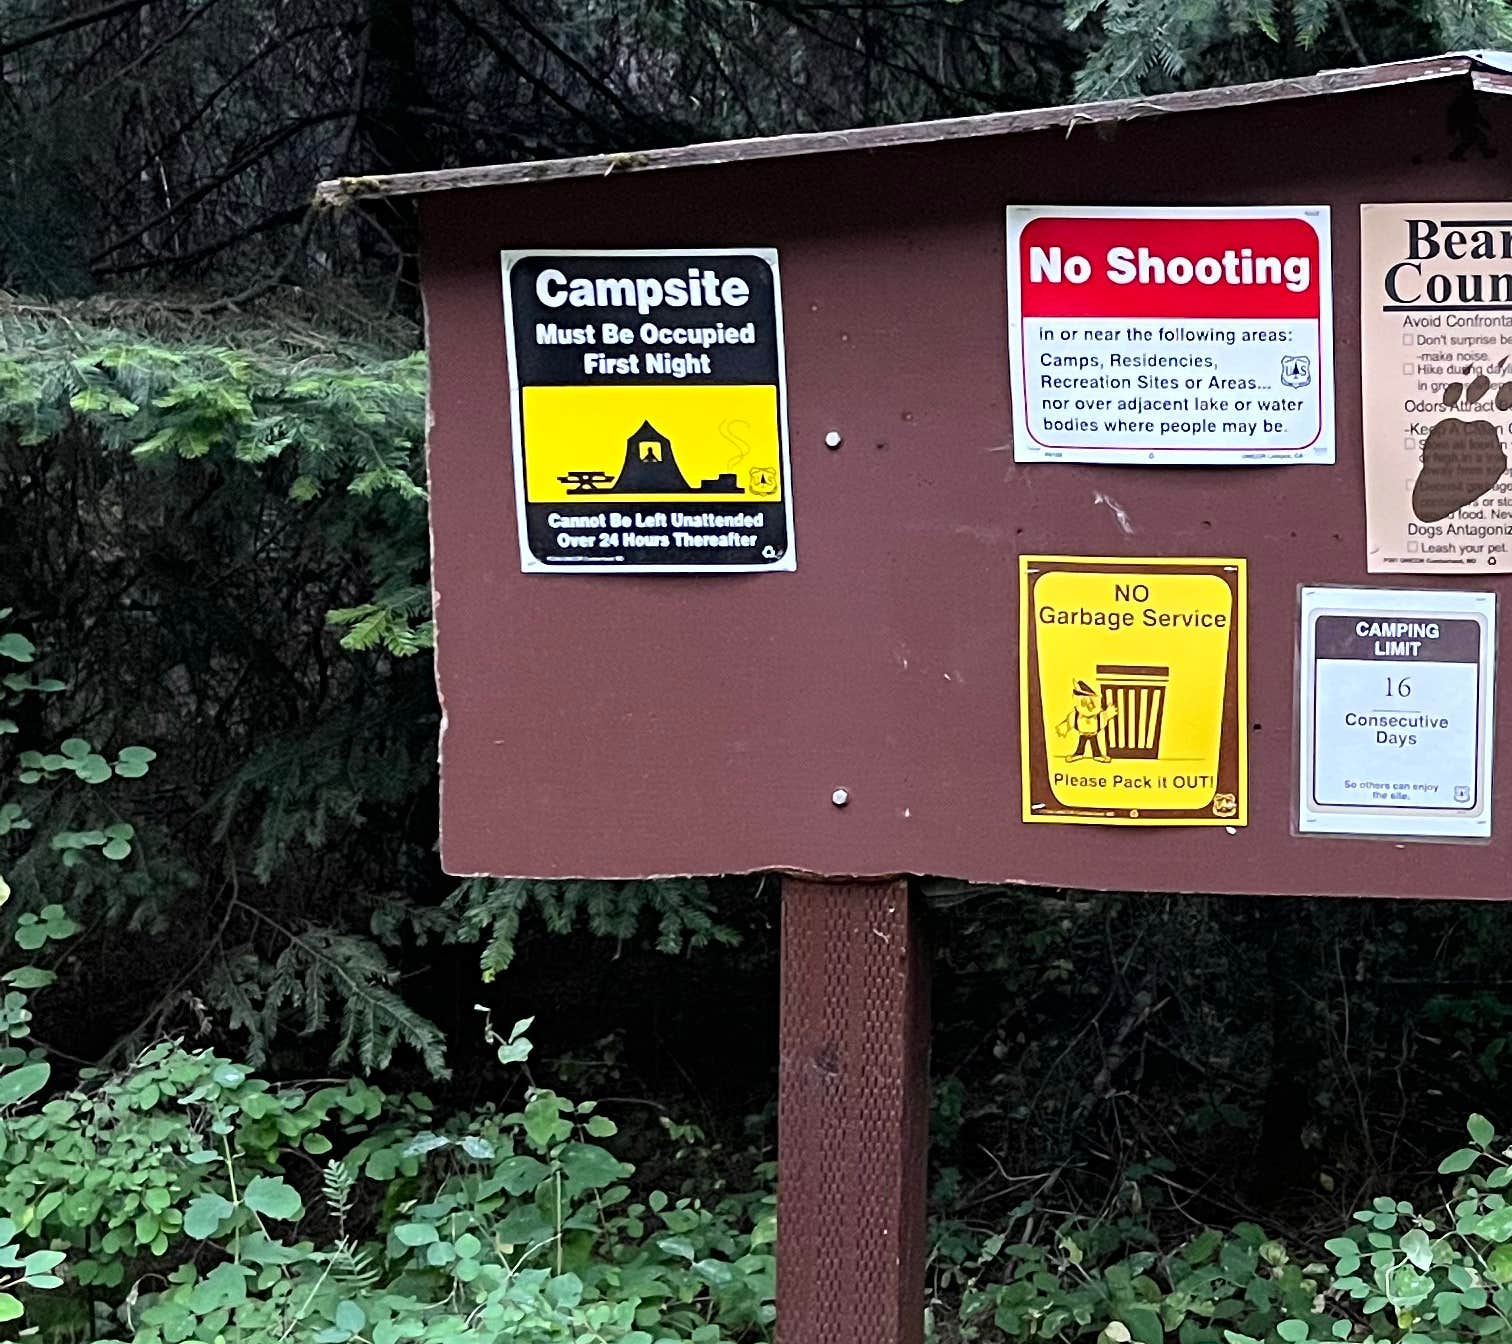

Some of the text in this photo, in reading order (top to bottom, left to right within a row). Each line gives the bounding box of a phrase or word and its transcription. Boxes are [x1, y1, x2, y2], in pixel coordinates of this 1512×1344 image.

[1030, 247, 1310, 292] No Shooting
[536, 268, 749, 314] Campsite
[1403, 316, 1441, 327] Avoid
[536, 323, 755, 348] Must Be Occupied
[1060, 330, 1078, 341] or
[1084, 330, 1121, 342] near
[1127, 328, 1152, 342] the
[1159, 328, 1235, 345] following
[1242, 330, 1293, 342] areas:
[1417, 335, 1446, 345] Don't
[1451, 336, 1496, 347] surprise
[584, 353, 711, 377] First Night
[1040, 354, 1218, 370] Camps, Residencies,
[1417, 365, 1443, 375] Hike
[1041, 376, 1271, 390] Recreation Sites or Areas...
[1042, 398, 1304, 414] nor over adjacent lake or water
[1404, 400, 1447, 412] Odors
[1044, 419, 1288, 436] bodies where people may be.
[1483, 498, 1495, 506] or
[548, 513, 764, 528] Cannot Be Left Unattended
[1408, 523, 1443, 538] Dogs
[557, 533, 757, 548] Over 24 Hours Thereafter
[1421, 544, 1455, 553] Leash
[1459, 545, 1483, 554] your
[1115, 585, 1149, 602] NO
[1040, 607, 1226, 630] Garbage Service
[1356, 621, 1439, 638] CAMPING
[1375, 641, 1421, 656] LIMIT
[1385, 677, 1412, 698] 16
[1346, 713, 1448, 729] Consecutive
[1376, 731, 1417, 747] Days
[1055, 774, 1213, 788] Please Pack it OUT!
[1359, 781, 1390, 789] others
[1412, 784, 1438, 792] enjoy
